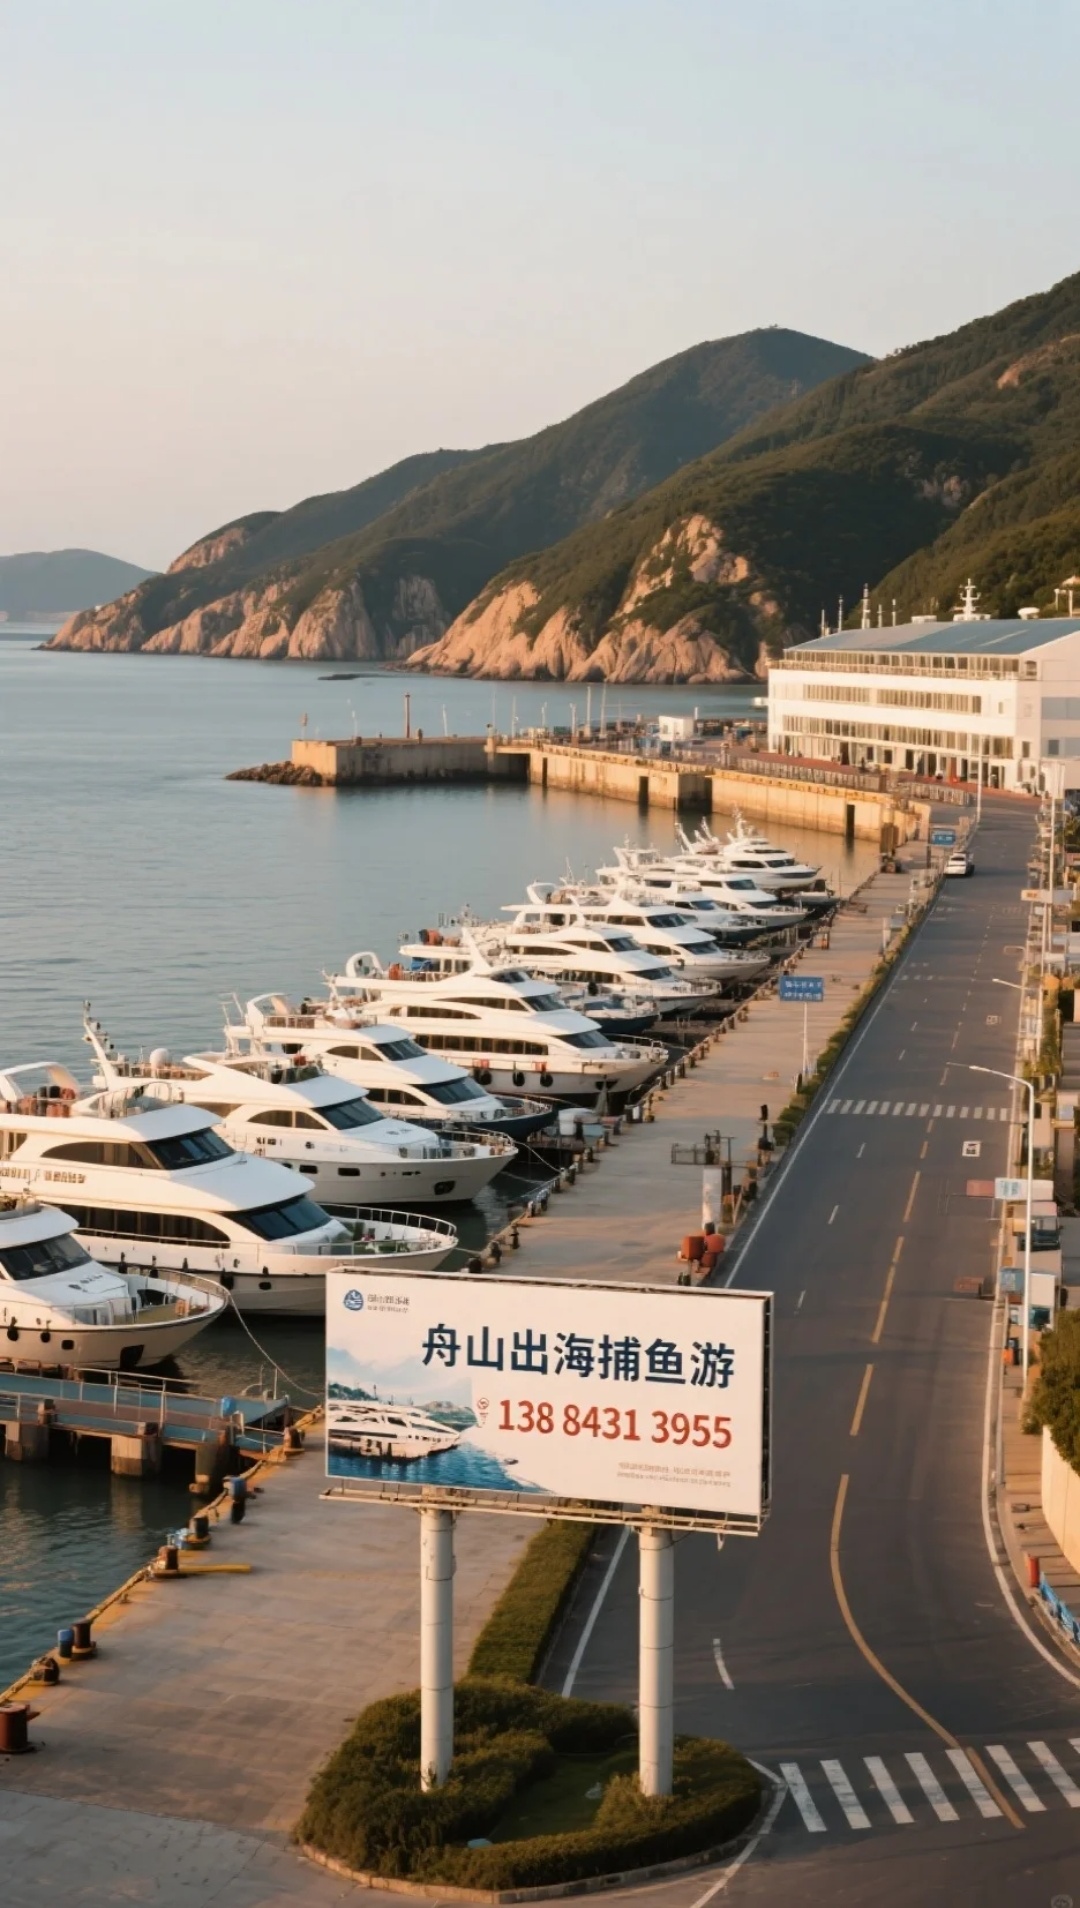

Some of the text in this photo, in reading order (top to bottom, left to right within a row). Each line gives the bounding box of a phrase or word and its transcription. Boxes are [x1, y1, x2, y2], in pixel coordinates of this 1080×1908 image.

[422, 1323, 735, 1389] 舟山出海捕鱼游
[498, 1399, 733, 1450] 138 8431 3955
